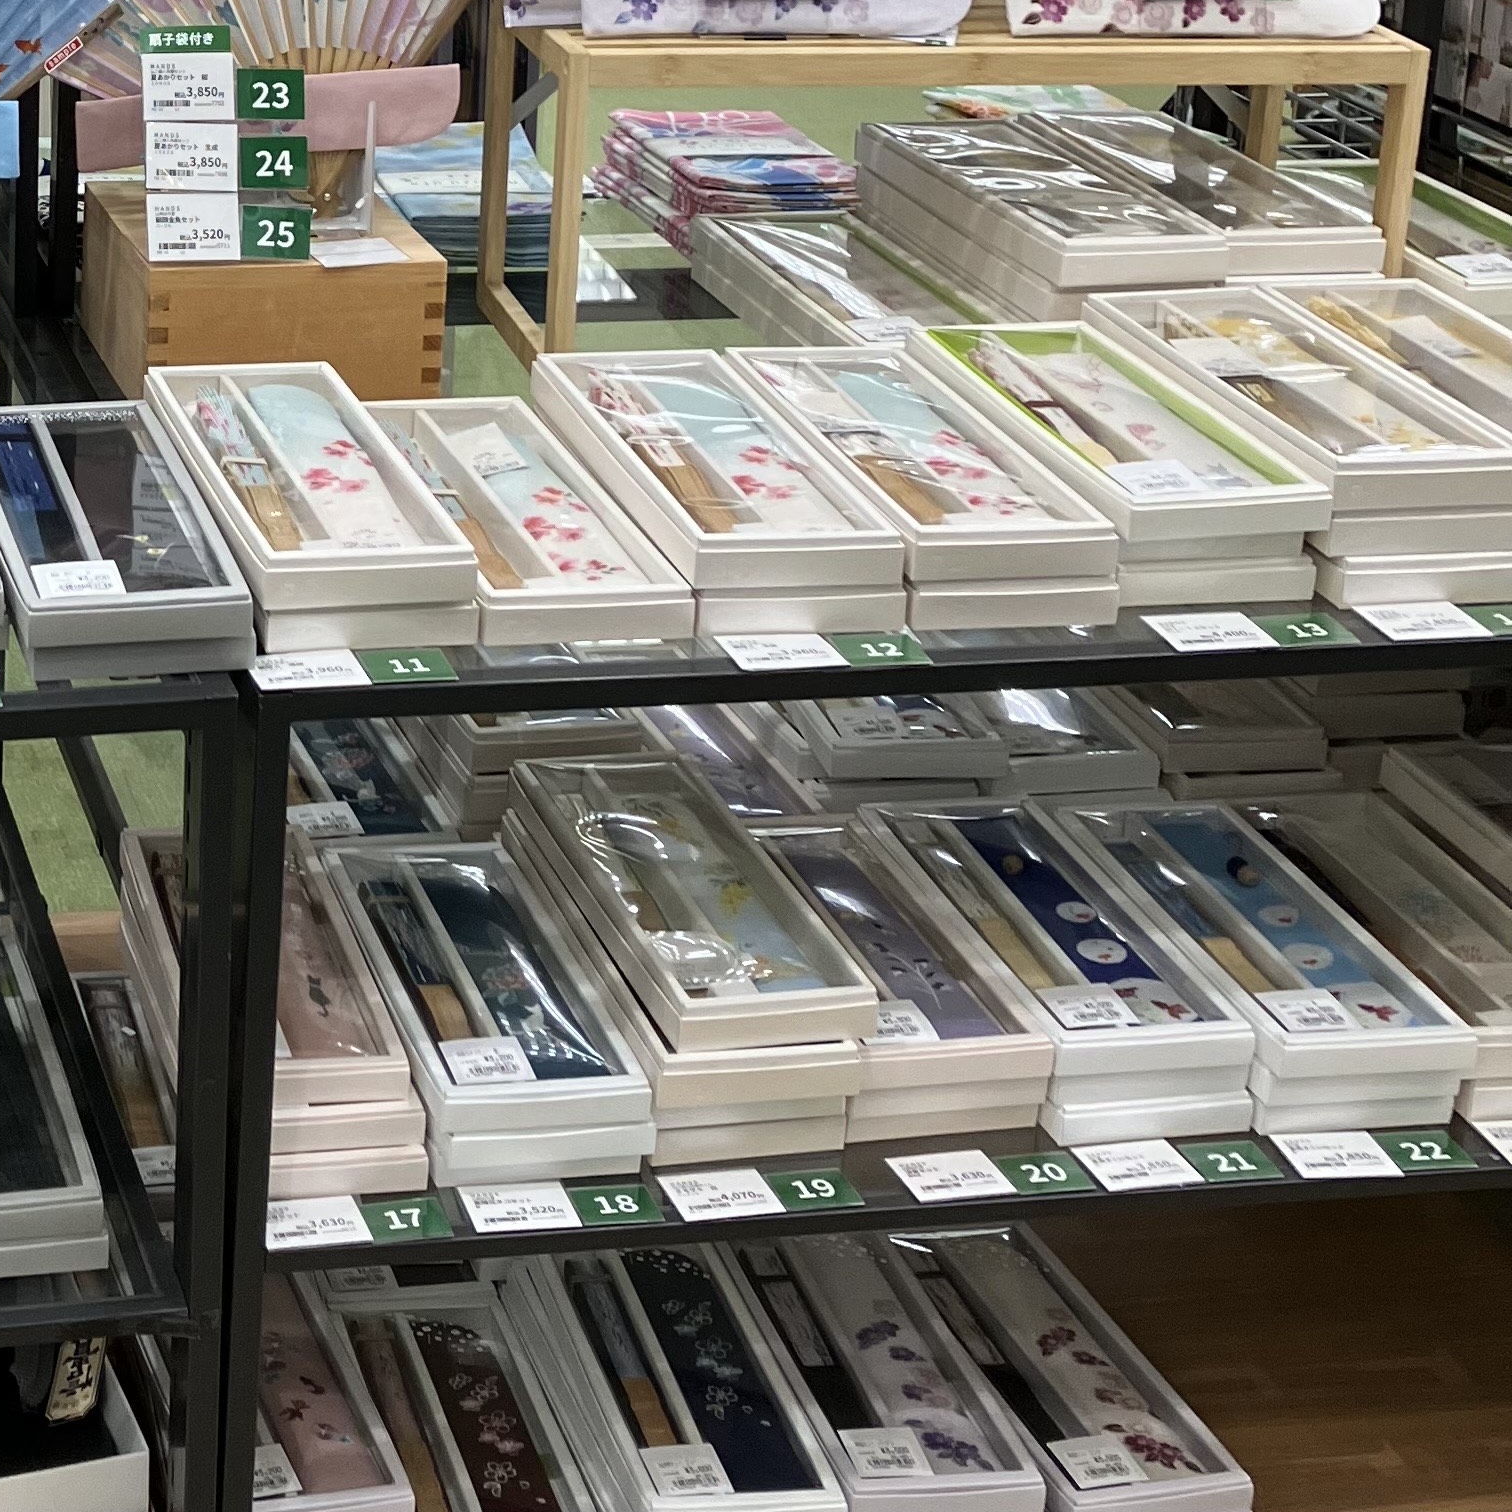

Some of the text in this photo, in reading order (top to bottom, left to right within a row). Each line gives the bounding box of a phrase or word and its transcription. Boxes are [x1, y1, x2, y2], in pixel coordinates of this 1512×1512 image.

[48, 42, 77, 68] sample
[252, 82, 290, 109] 23
[255, 150, 294, 177] 24
[256, 220, 296, 248] 25
[1286, 623, 1328, 637] 13
[861, 643, 904, 656] 12
[388, 658, 430, 673] 11
[1399, 1141, 1451, 1160] 22
[1207, 1152, 1257, 1172] 21
[1020, 1163, 1067, 1183] 20
[791, 1179, 835, 1199] 19
[594, 1195, 639, 1214] 18
[384, 1208, 421, 1230] 17
